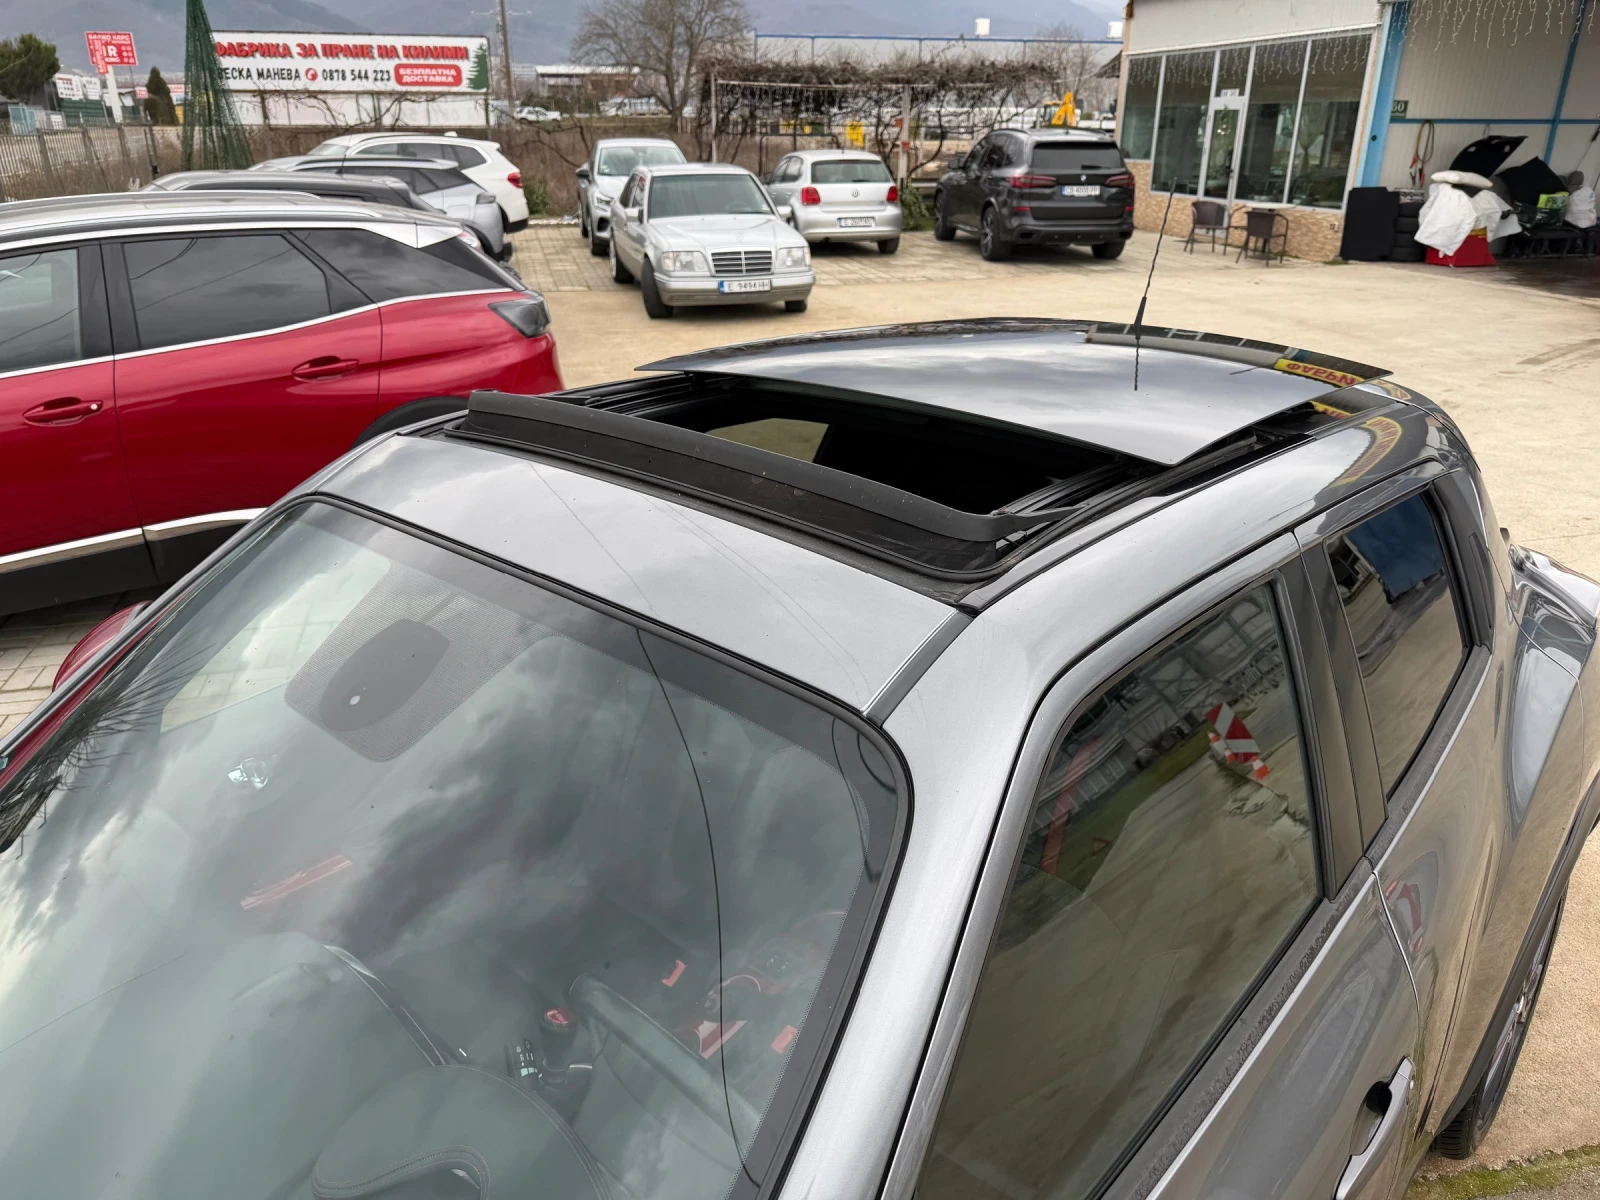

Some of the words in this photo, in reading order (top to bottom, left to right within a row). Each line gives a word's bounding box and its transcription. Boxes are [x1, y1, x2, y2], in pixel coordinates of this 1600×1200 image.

[296, 43, 320, 58] ЗА
[320, 43, 374, 59] ПРАНЕ
[376, 44, 400, 59] НА
[401, 45, 469, 60] КИЛИМИ
[256, 68, 300, 80] МАНЕВА
[321, 69, 347, 81] 0878
[351, 69, 369, 81] 544
[373, 70, 391, 81] 223
[399, 68, 456, 76] БЕЗПЛАТНА
[402, 75, 454, 83] ДОСТАВКА
[728, 282, 734, 291] E
